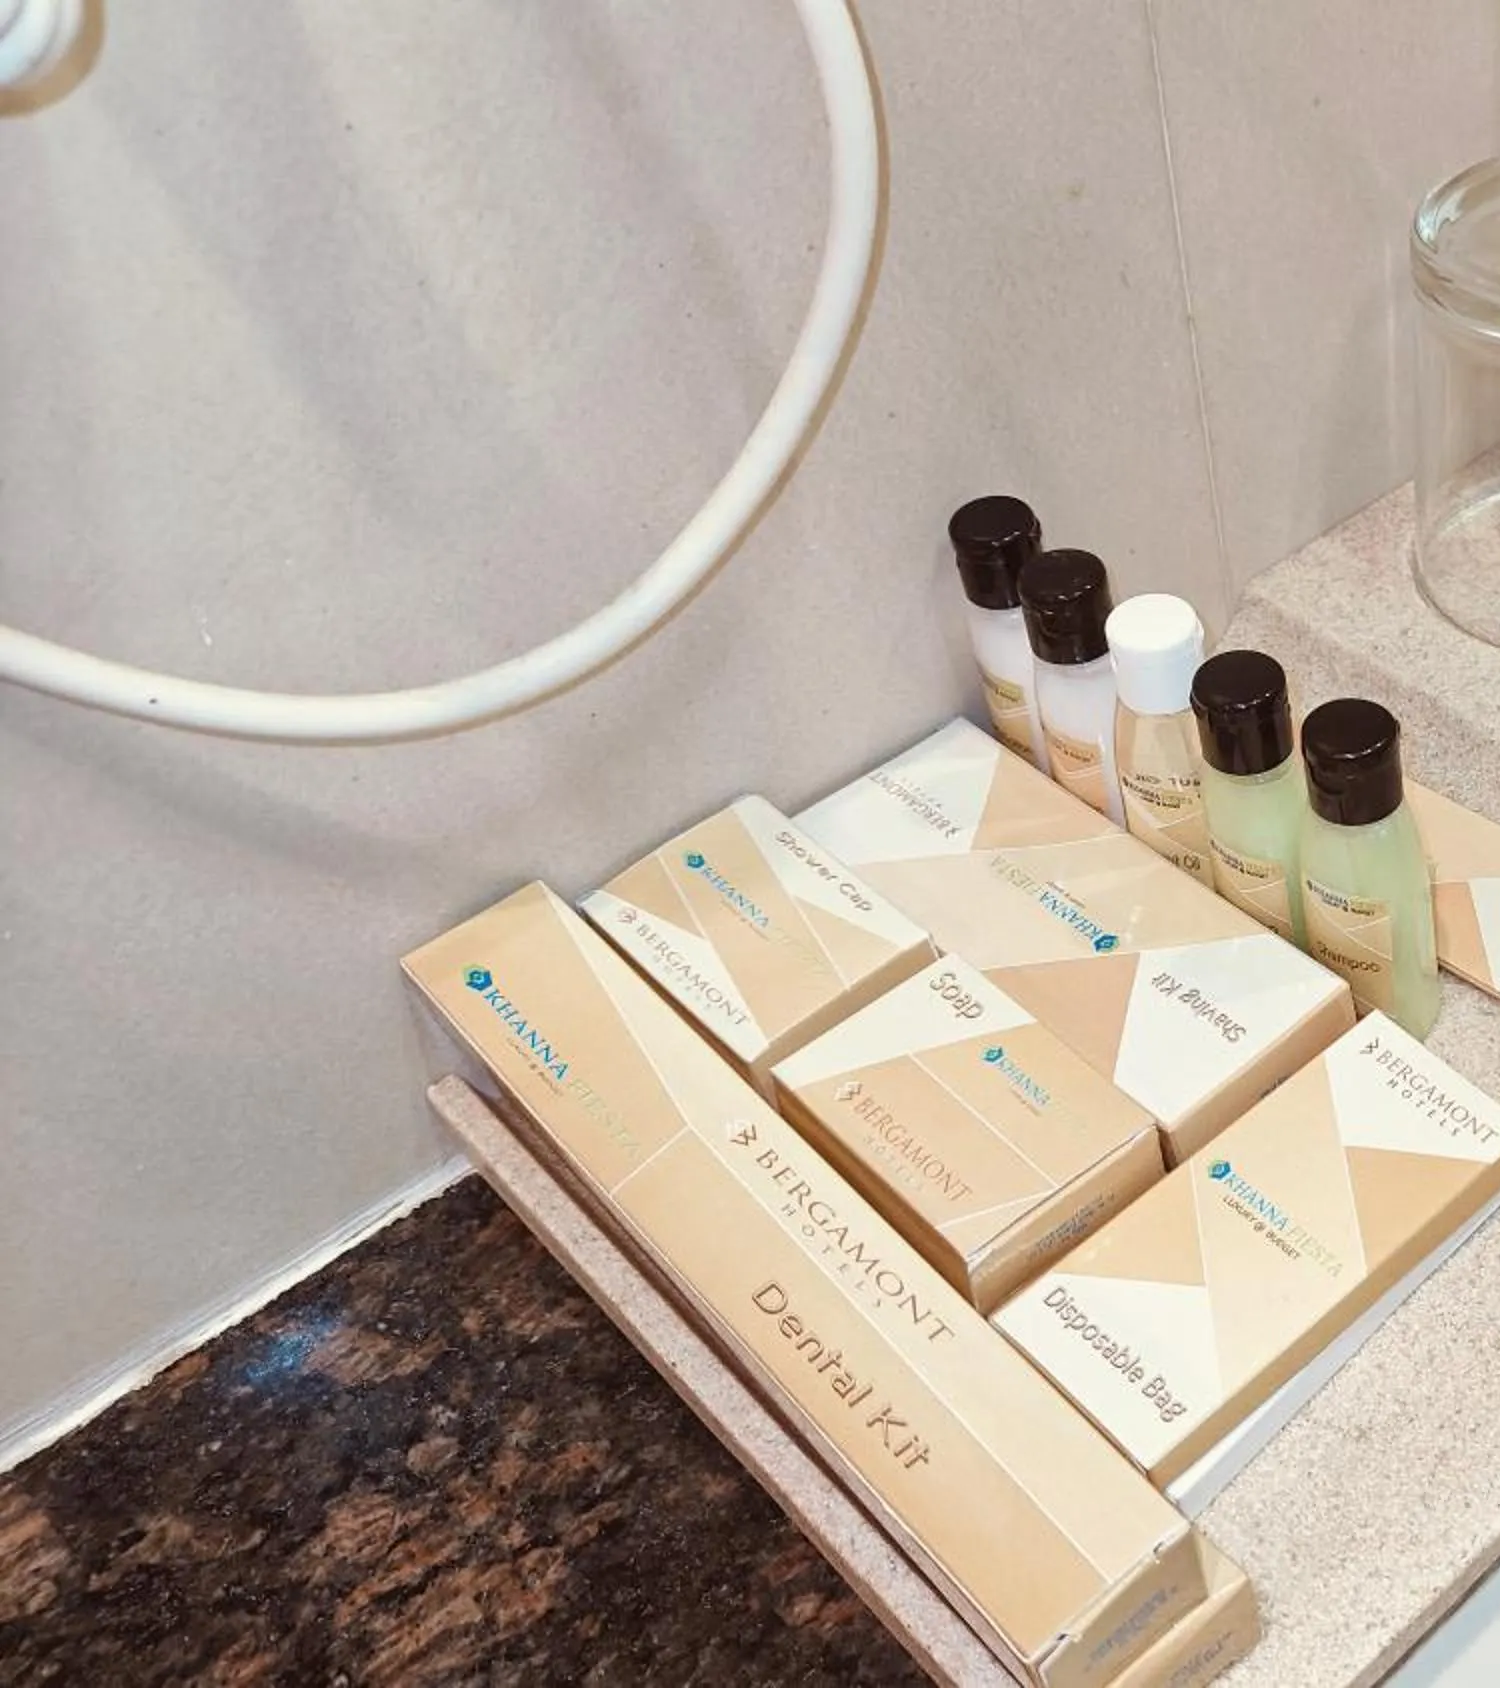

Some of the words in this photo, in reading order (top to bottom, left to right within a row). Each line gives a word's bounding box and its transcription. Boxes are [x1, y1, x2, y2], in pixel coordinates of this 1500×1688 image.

[699, 866, 770, 929] KHANNA
[775, 830, 838, 881] Shower
[839, 882, 872, 912] Cap
[1038, 890, 1103, 940] KHANNA
[637, 923, 748, 1026] BERGAMONT
[929, 972, 985, 1019] Soap
[1151, 972, 1184, 997] Kit
[1177, 987, 1247, 1043] Shaving
[483, 988, 569, 1081] KHANNA
[1375, 1048, 1500, 1143] BERGAMONT
[852, 1098, 973, 1200] BERGAMONT
[756, 1148, 956, 1343] BERGAMONT
[1222, 1172, 1290, 1232] KHANNA
[752, 1281, 874, 1408] Dental
[866, 1406, 930, 1469] Kit
[1041, 1285, 1146, 1384] Disposable
[1141, 1373, 1188, 1424] Bag
